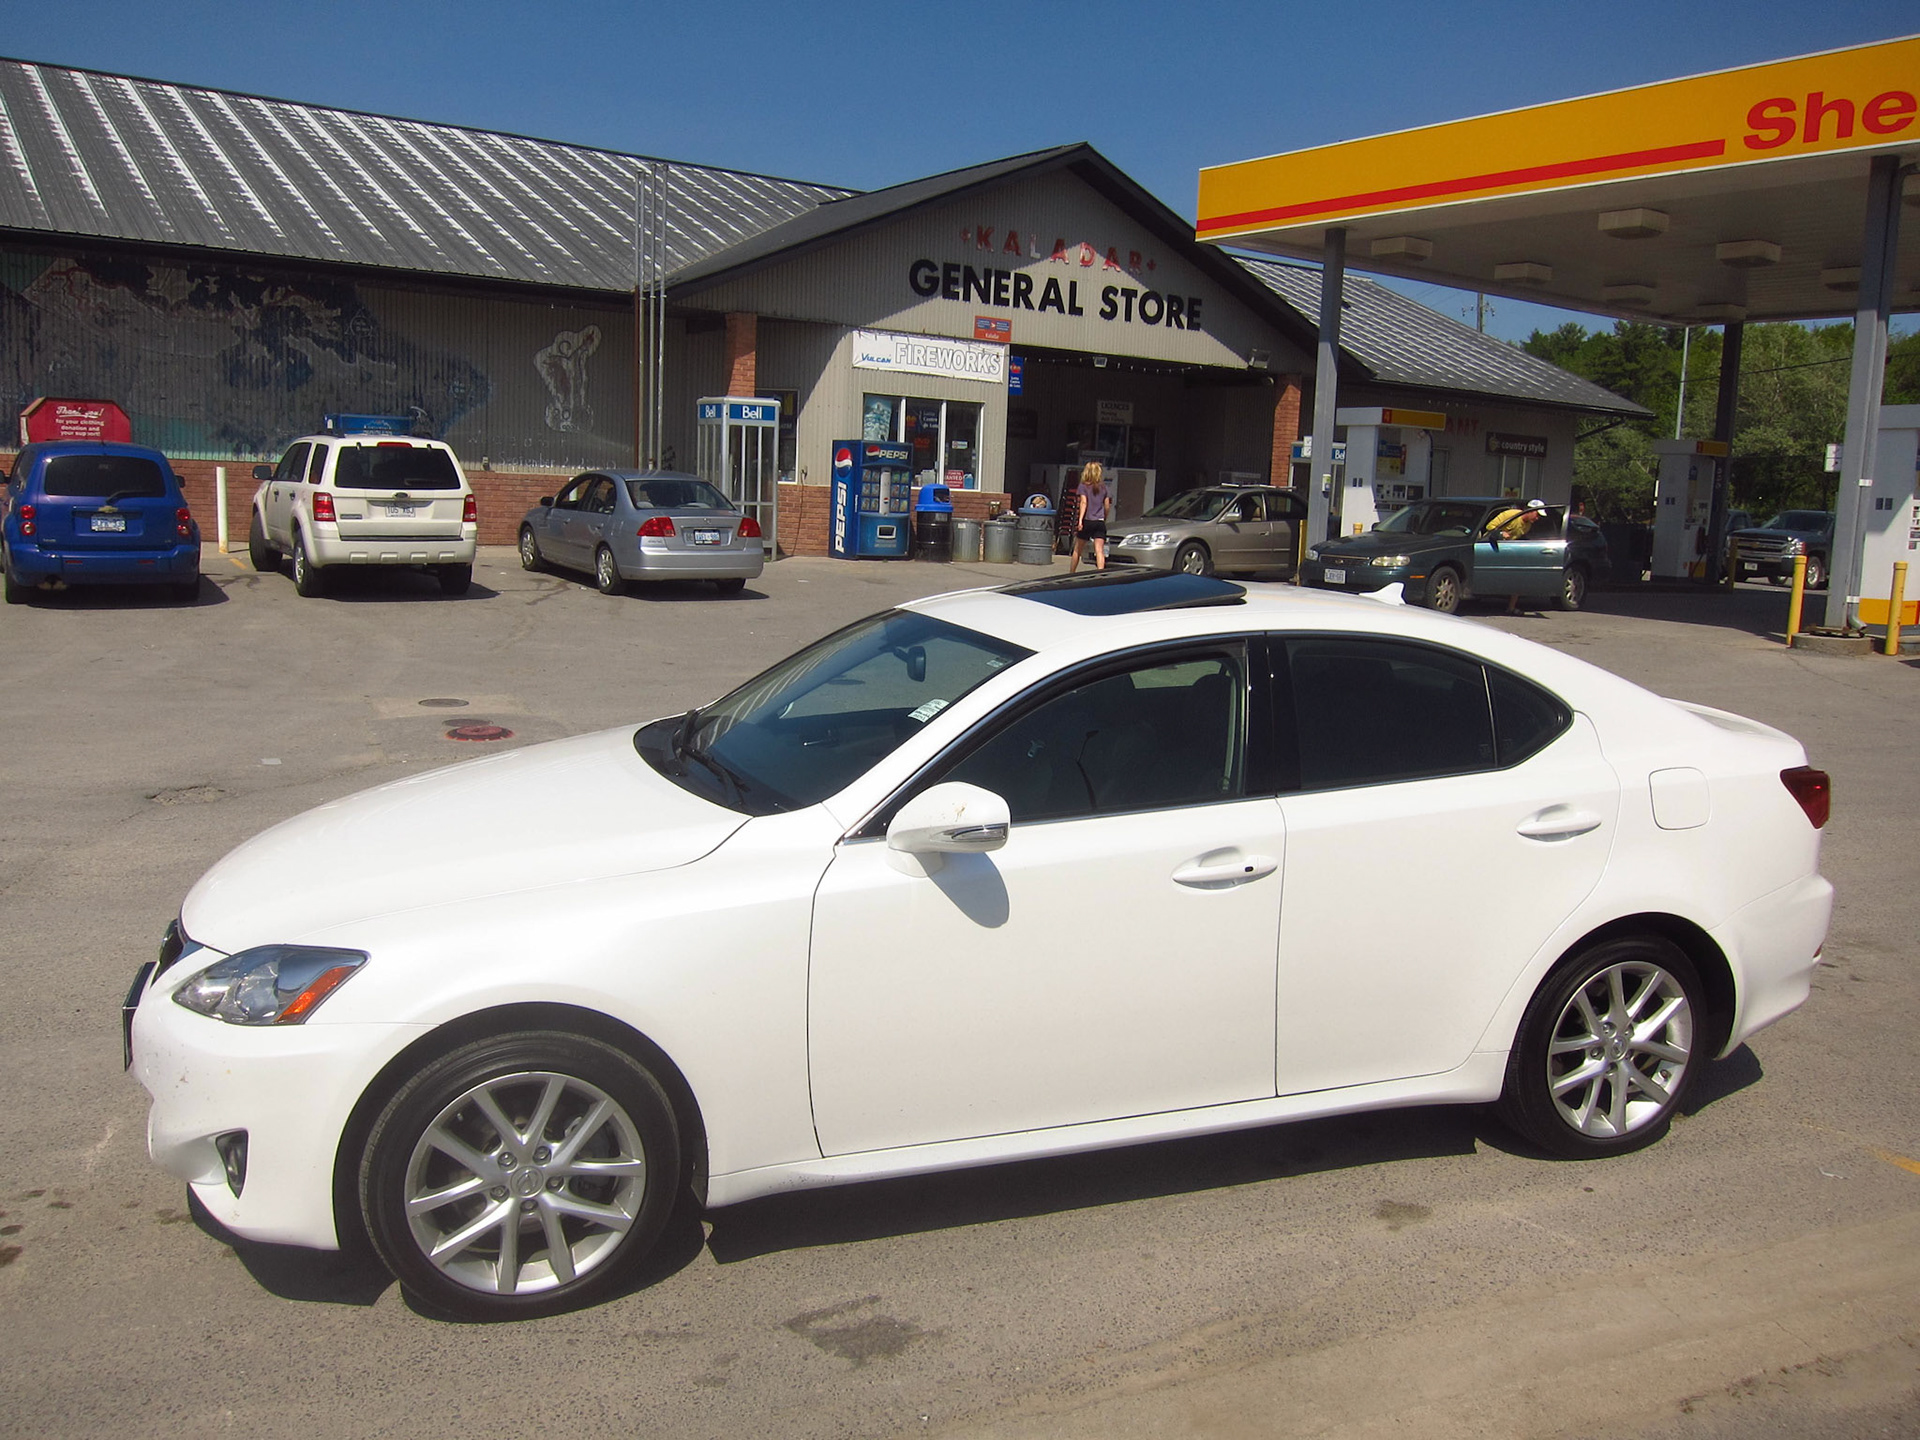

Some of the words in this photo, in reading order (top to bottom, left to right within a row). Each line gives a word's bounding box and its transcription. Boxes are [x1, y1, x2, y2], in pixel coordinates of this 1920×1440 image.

[976, 225, 1143, 275] KALADAR
[909, 258, 1084, 317] GENERAL
[1099, 285, 1203, 331] STORE
[895, 342, 1001, 375] FIREWORKS
[705, 405, 716, 418] Bell
[742, 406, 762, 419] Bell
[878, 449, 909, 460] PEPSI
[1501, 441, 1527, 453] country
[1528, 443, 1545, 454] style
[835, 481, 847, 554] PEPSI
